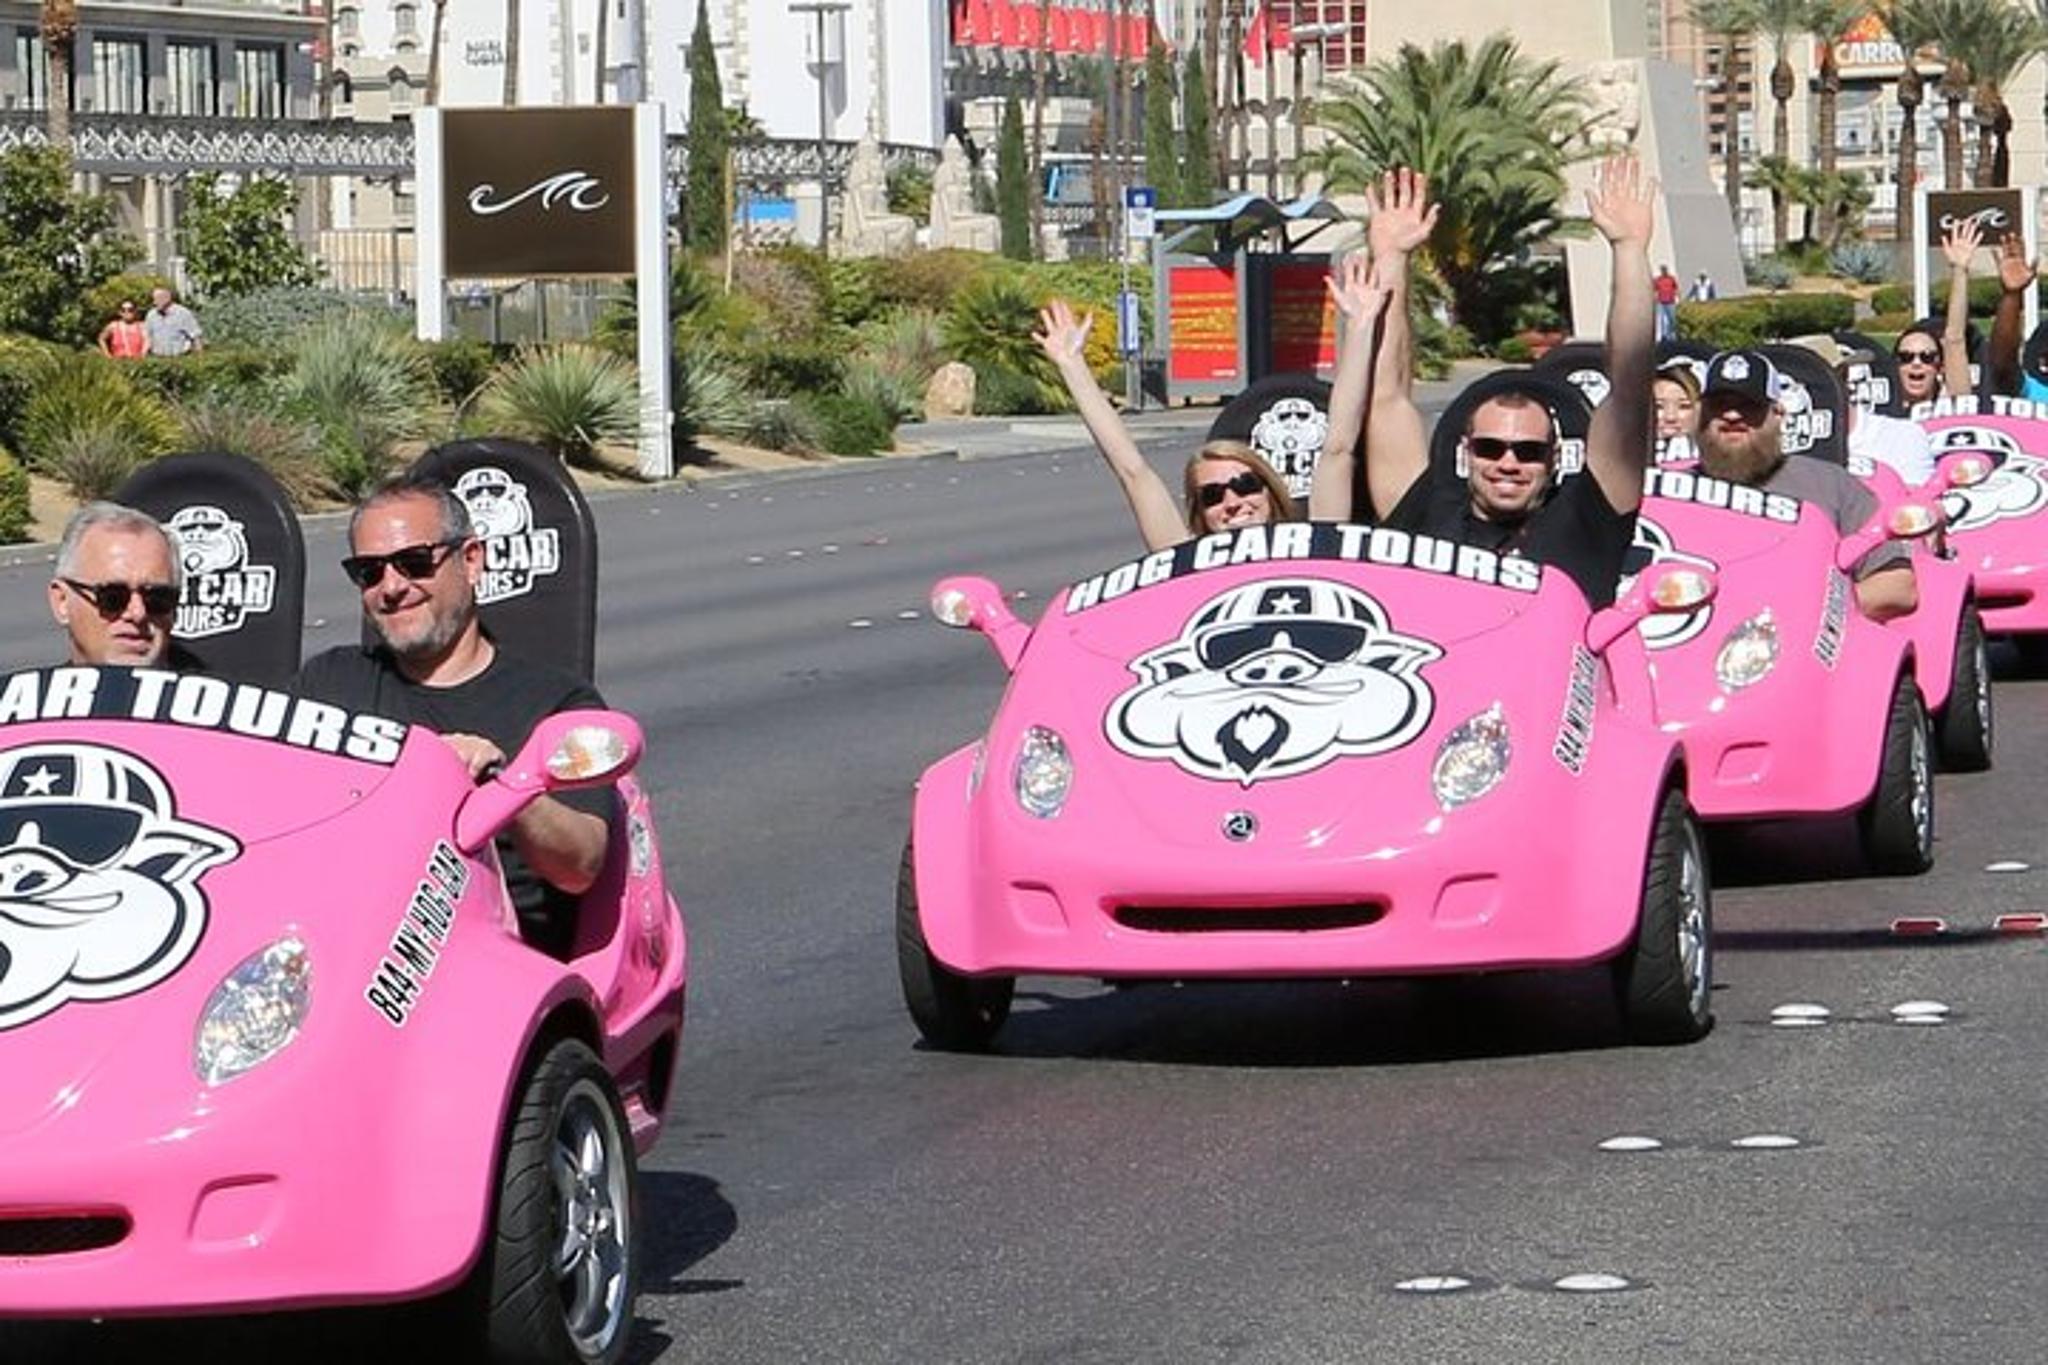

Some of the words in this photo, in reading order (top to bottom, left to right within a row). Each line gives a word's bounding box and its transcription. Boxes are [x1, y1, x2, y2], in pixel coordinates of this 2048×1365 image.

[1834, 42, 1909, 65] CARR
[1911, 395, 1978, 420] CAR
[486, 534, 553, 570] CAR
[1066, 549, 1175, 614] HOG
[1194, 522, 1312, 570] CAR
[1336, 524, 1540, 592] TOURS
[199, 573, 267, 606] CAR
[131, 668, 405, 765] TOURS
